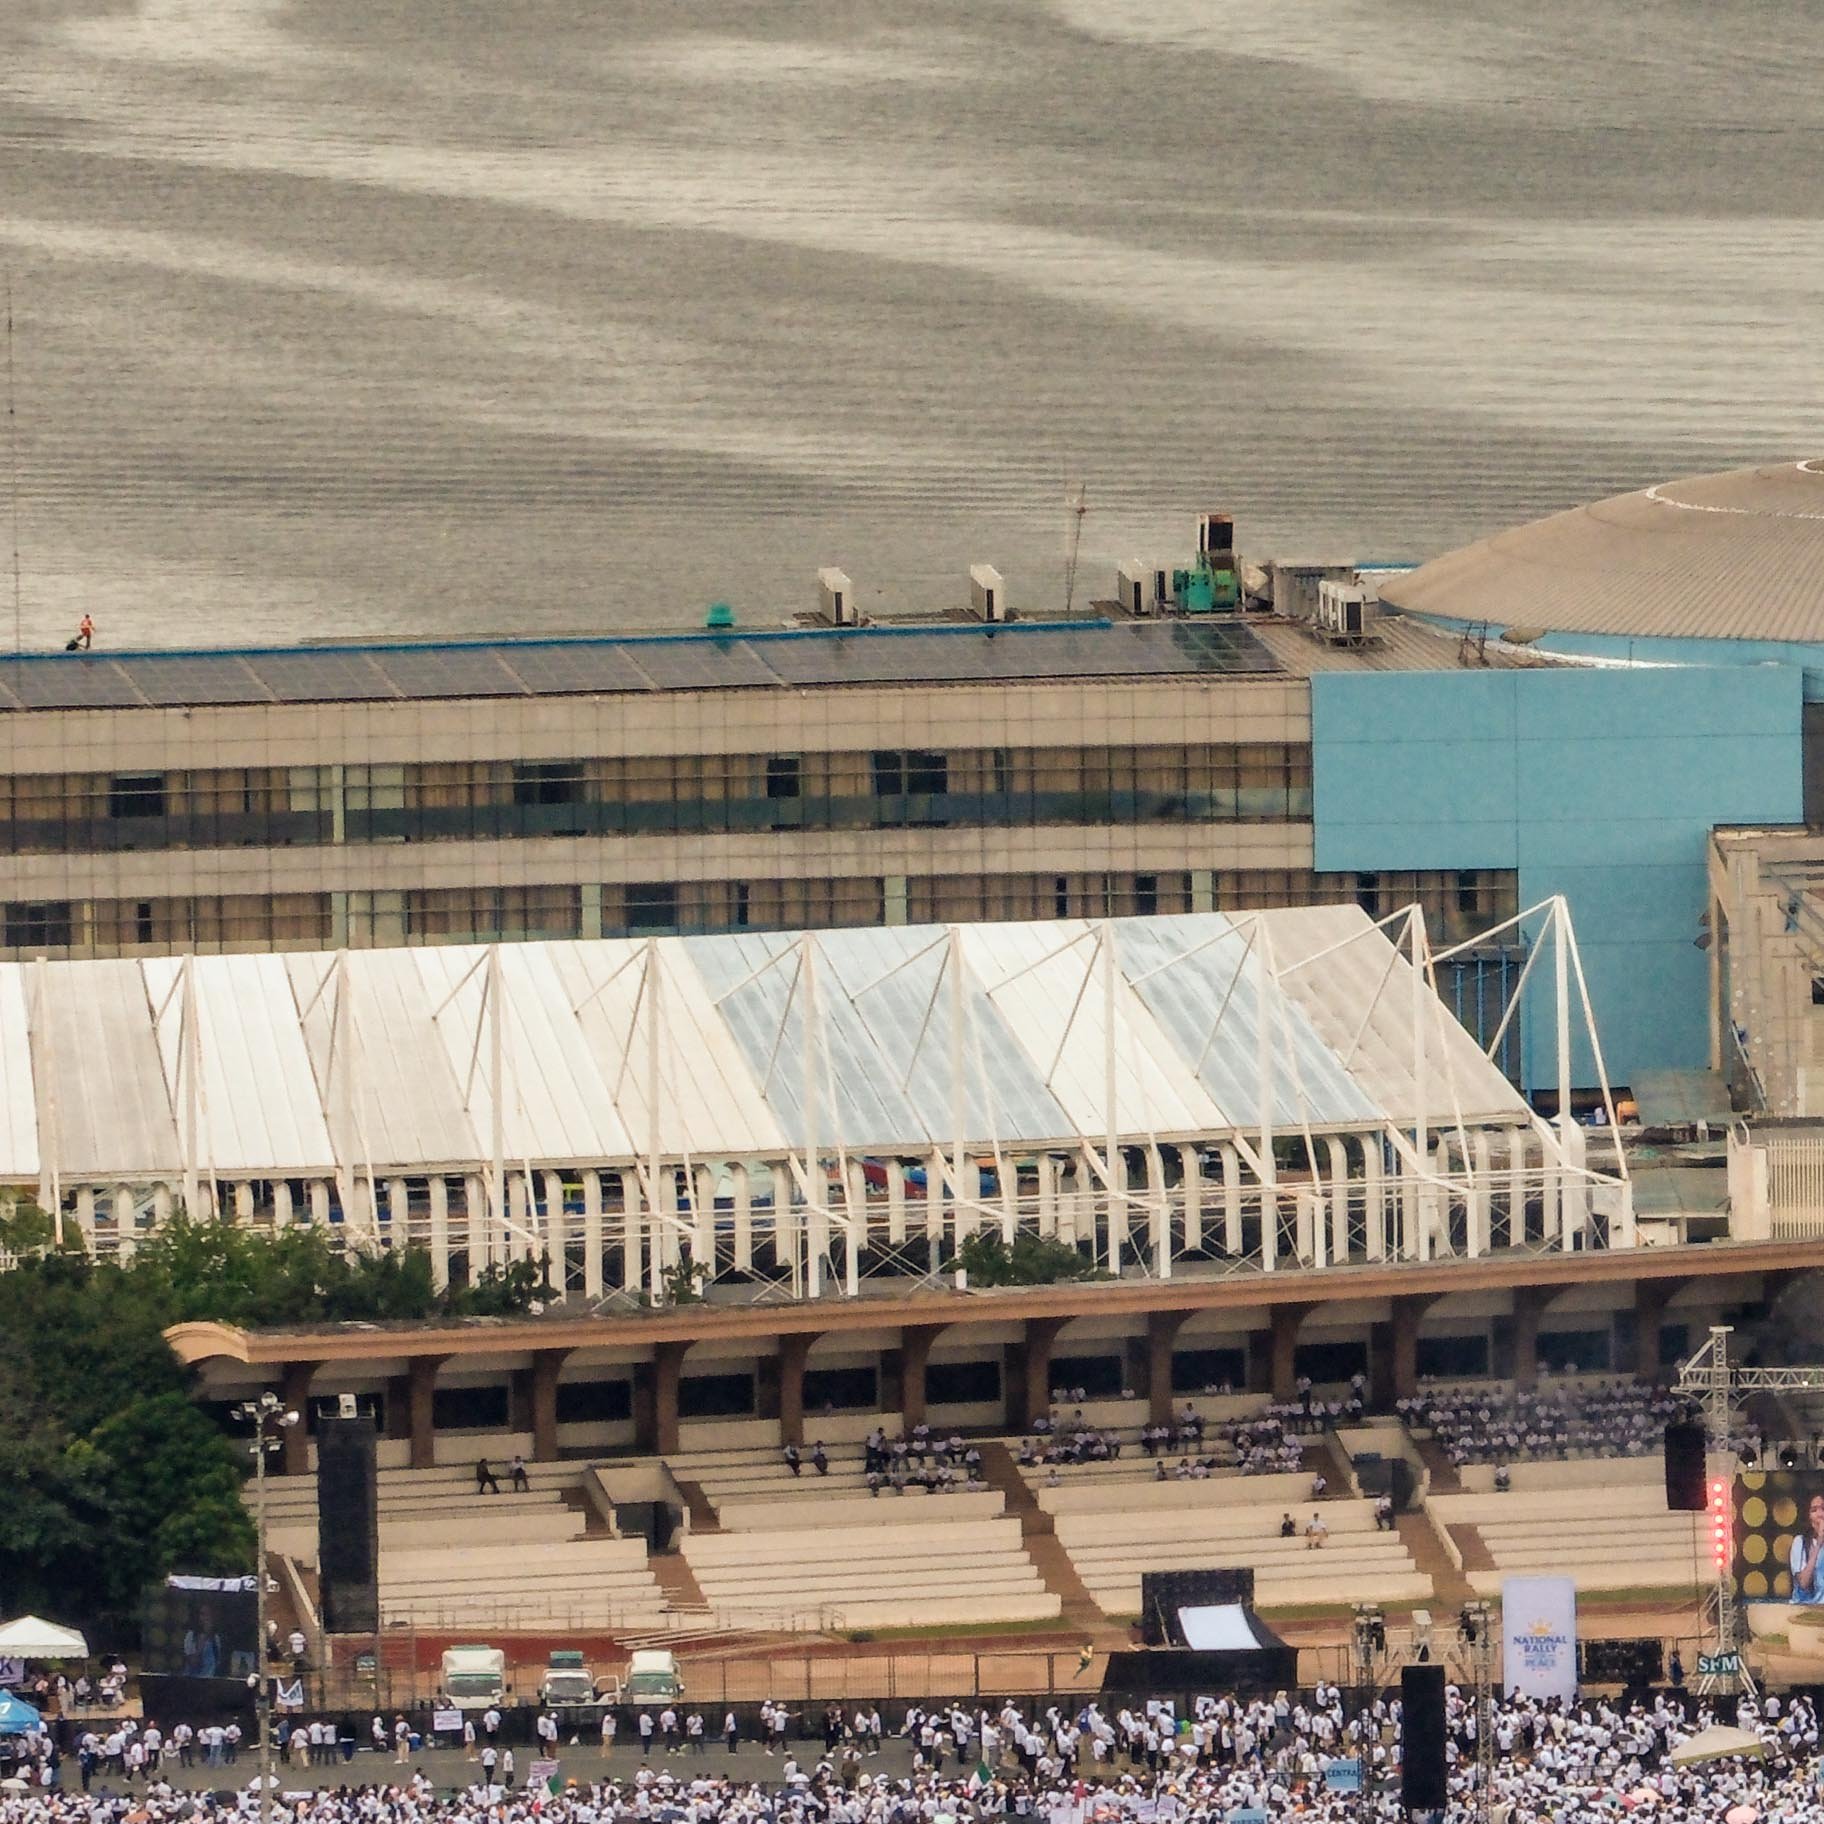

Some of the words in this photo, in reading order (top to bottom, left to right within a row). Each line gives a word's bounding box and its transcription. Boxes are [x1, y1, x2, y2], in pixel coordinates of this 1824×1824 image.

[1513, 1635, 1567, 1645] NATIONAL
[1524, 1644, 1557, 1653] RALLY
[1327, 1768, 1359, 1778] CENTRA
